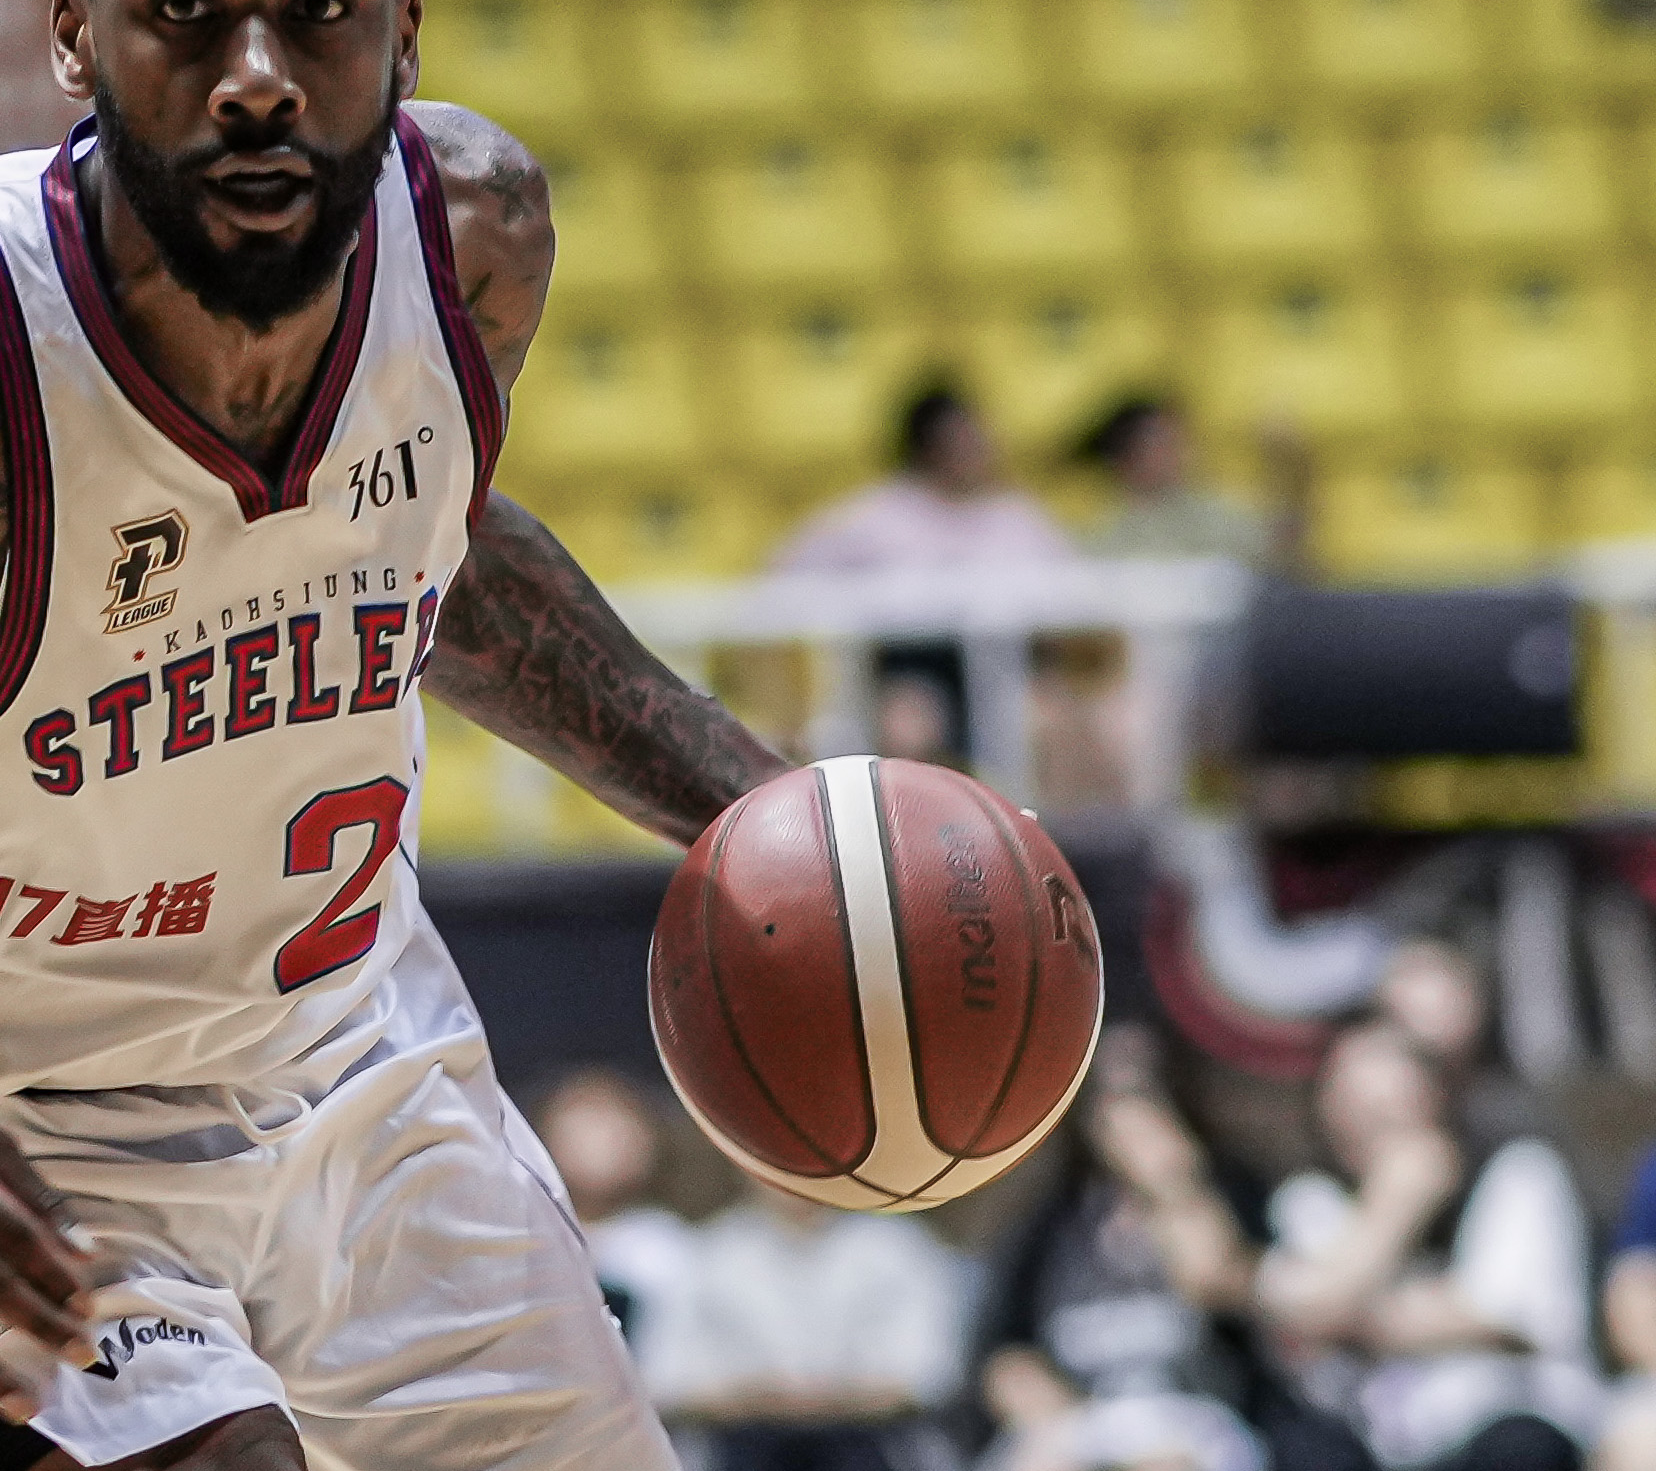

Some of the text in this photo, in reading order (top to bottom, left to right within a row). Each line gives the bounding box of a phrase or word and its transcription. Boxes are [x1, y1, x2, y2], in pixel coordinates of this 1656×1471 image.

[347, 426, 434, 523] 361°
[111, 595, 172, 629] LEAGUE
[164, 567, 397, 655] KAOHSIUNG
[274, 775, 409, 996] 2
